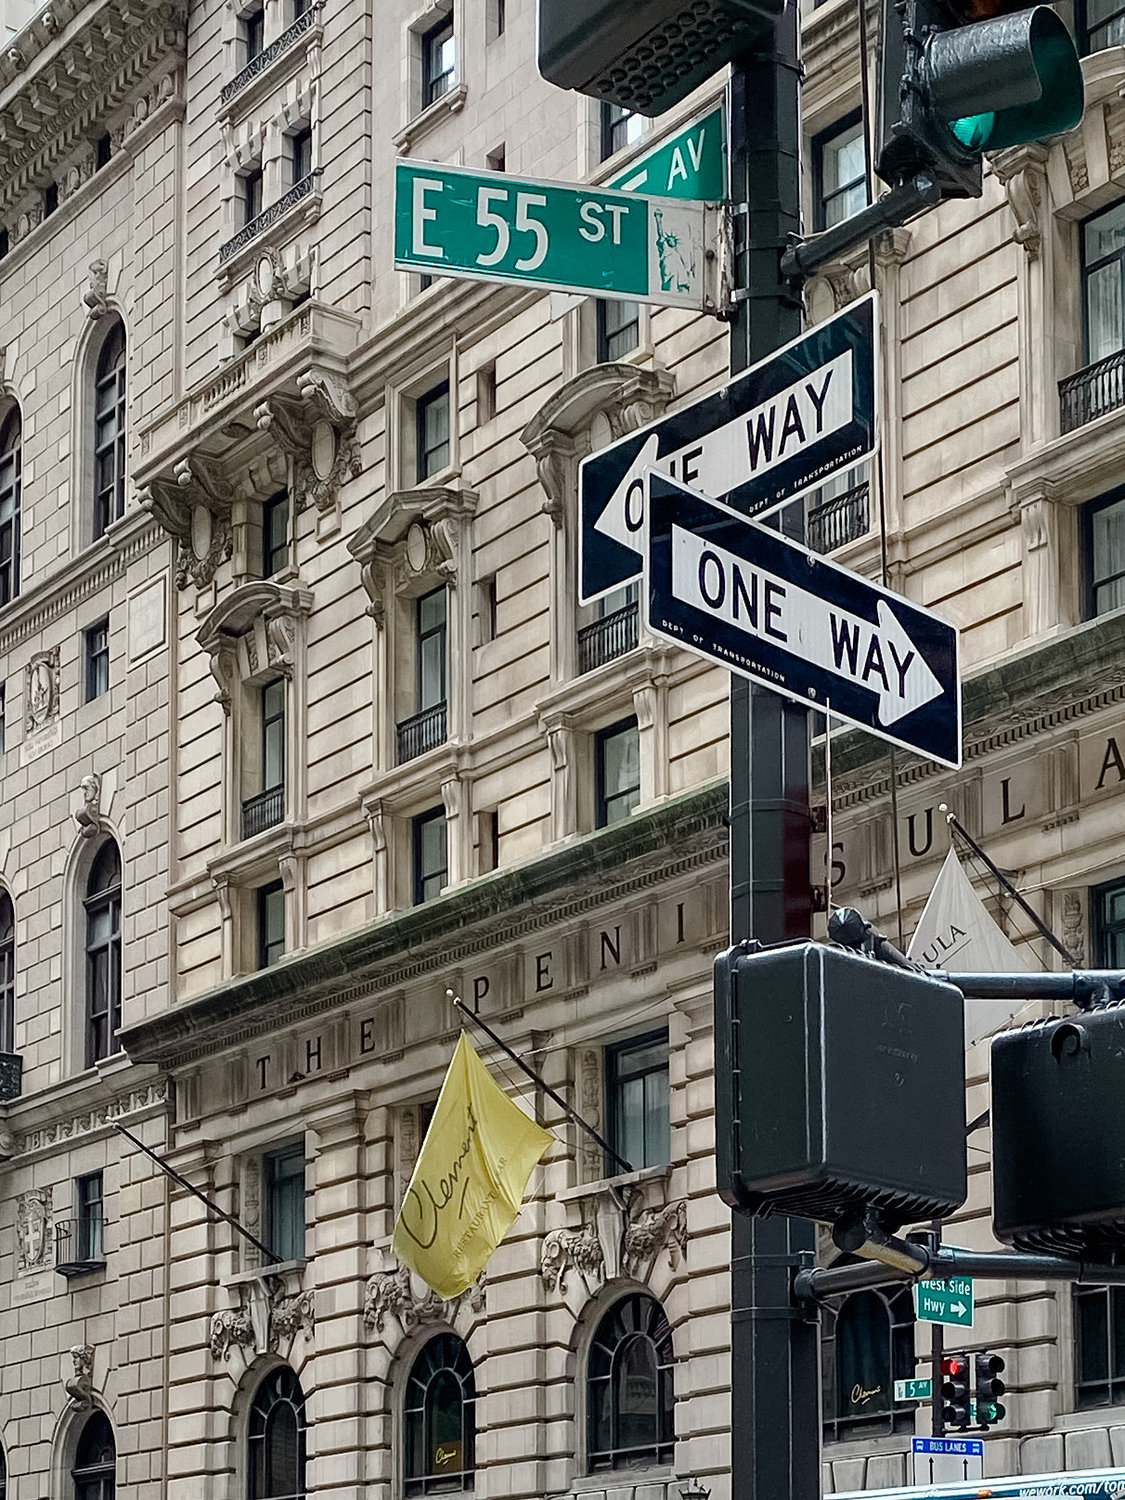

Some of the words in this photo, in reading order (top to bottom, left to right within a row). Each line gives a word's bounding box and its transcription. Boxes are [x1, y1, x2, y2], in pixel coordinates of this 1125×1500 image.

[667, 129, 706, 191] AV
[412, 177, 443, 258] E
[475, 186, 549, 271] 55
[578, 201, 630, 245] ST
[746, 369, 834, 472] WAY
[749, 498, 769, 513] DEPT
[793, 445, 863, 488] TRANSPORTATION
[662, 619, 684, 635] DEPT
[693, 634, 704, 644] OF
[712, 642, 785, 682] TRANSPORTATION
[698, 550, 788, 643] ONE
[829, 612, 915, 698] WAY
[255, 1017, 376, 1090] THE
[921, 1280, 946, 1292] West
[949, 1280, 971, 1296] Side
[924, 1298, 945, 1316] Hwy
[910, 1382, 916, 1397] 5
[929, 1442, 943, 1451] BUS
[945, 1442, 967, 1453] LANES
